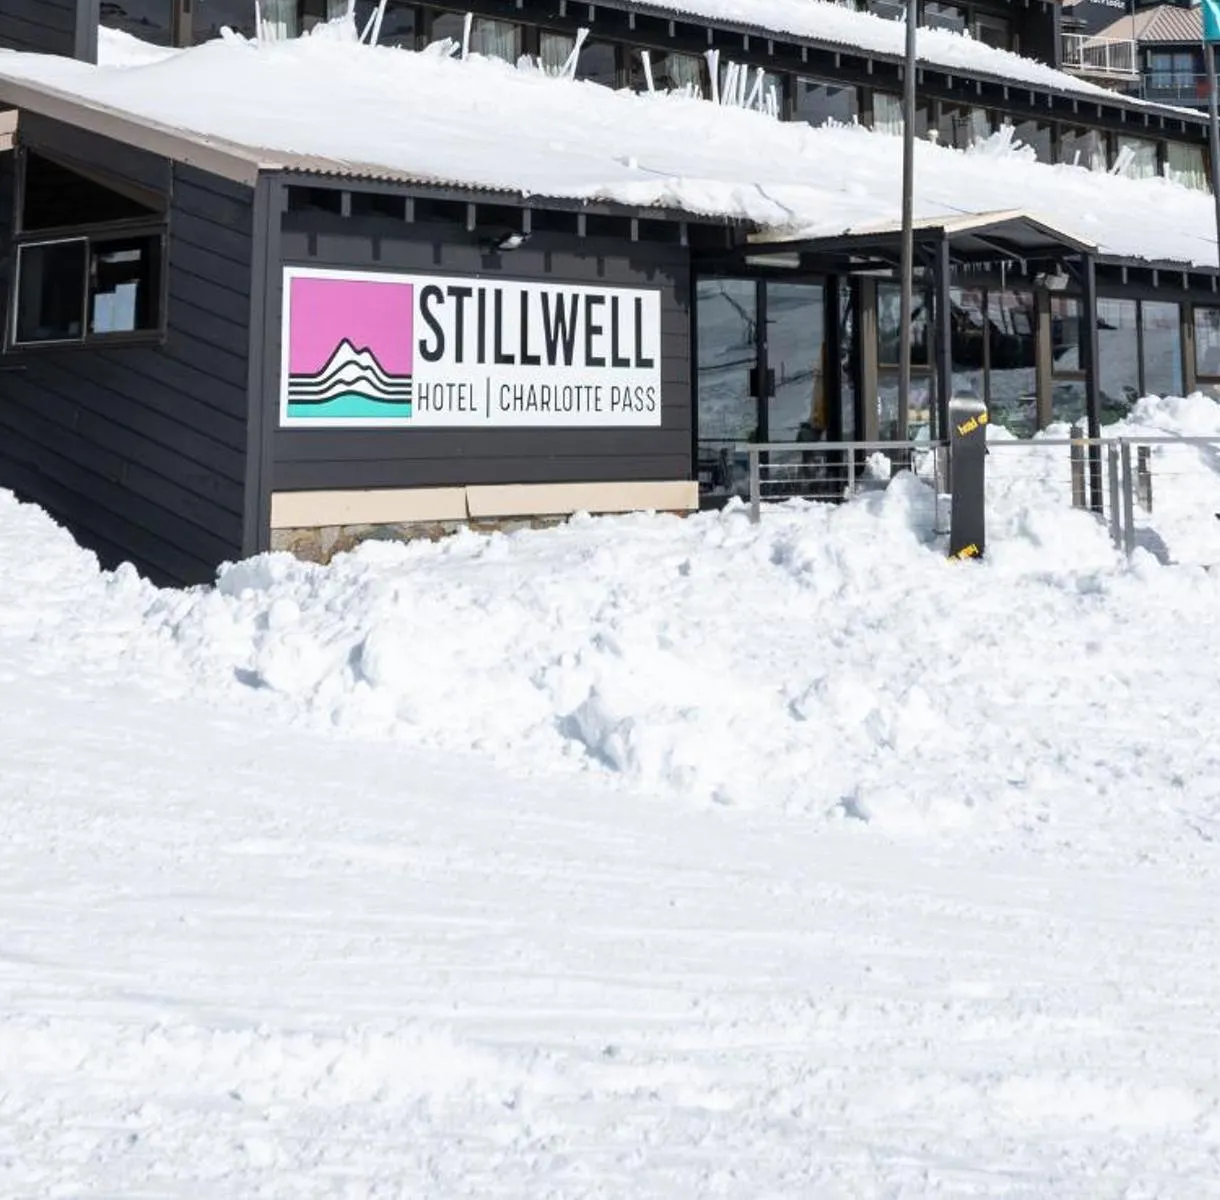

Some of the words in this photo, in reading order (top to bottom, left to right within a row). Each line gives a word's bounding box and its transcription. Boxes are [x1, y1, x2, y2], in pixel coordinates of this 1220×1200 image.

[418, 284, 655, 369] STILLWELL
[417, 382, 477, 413] HOTEL
[499, 383, 606, 414] CHARLOTTE
[611, 385, 657, 414] PASS
